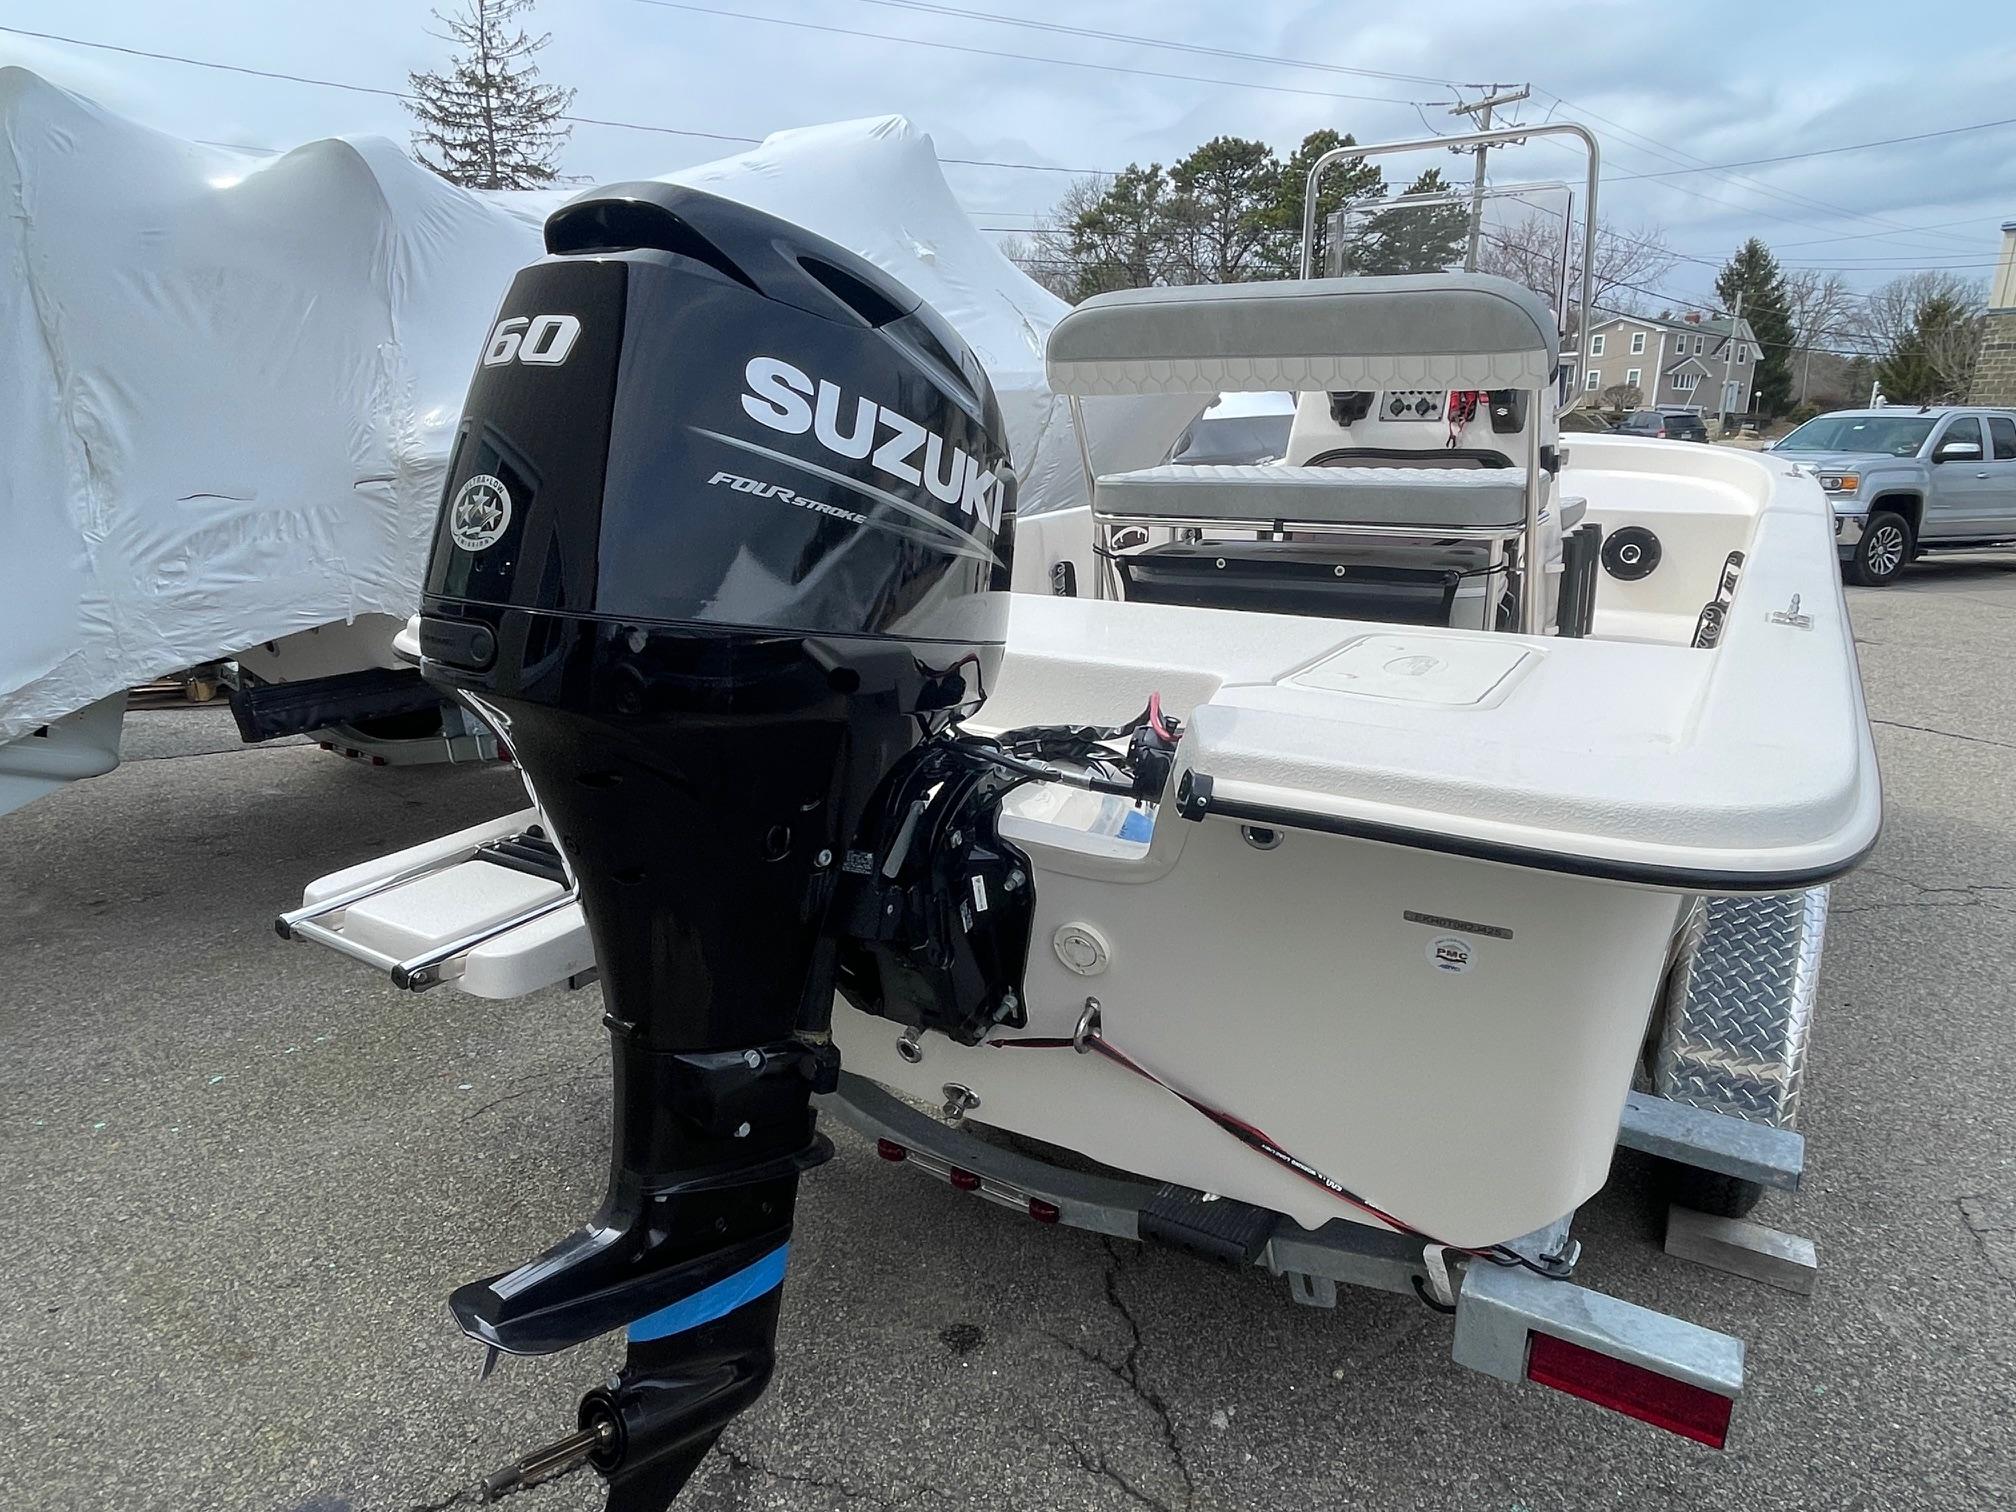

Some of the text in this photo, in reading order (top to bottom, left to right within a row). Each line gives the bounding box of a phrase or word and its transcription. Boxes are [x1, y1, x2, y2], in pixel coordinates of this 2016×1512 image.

[484, 315, 581, 367] 60
[741, 356, 1004, 536] SUZUKI
[1436, 947, 1468, 960] PMC
